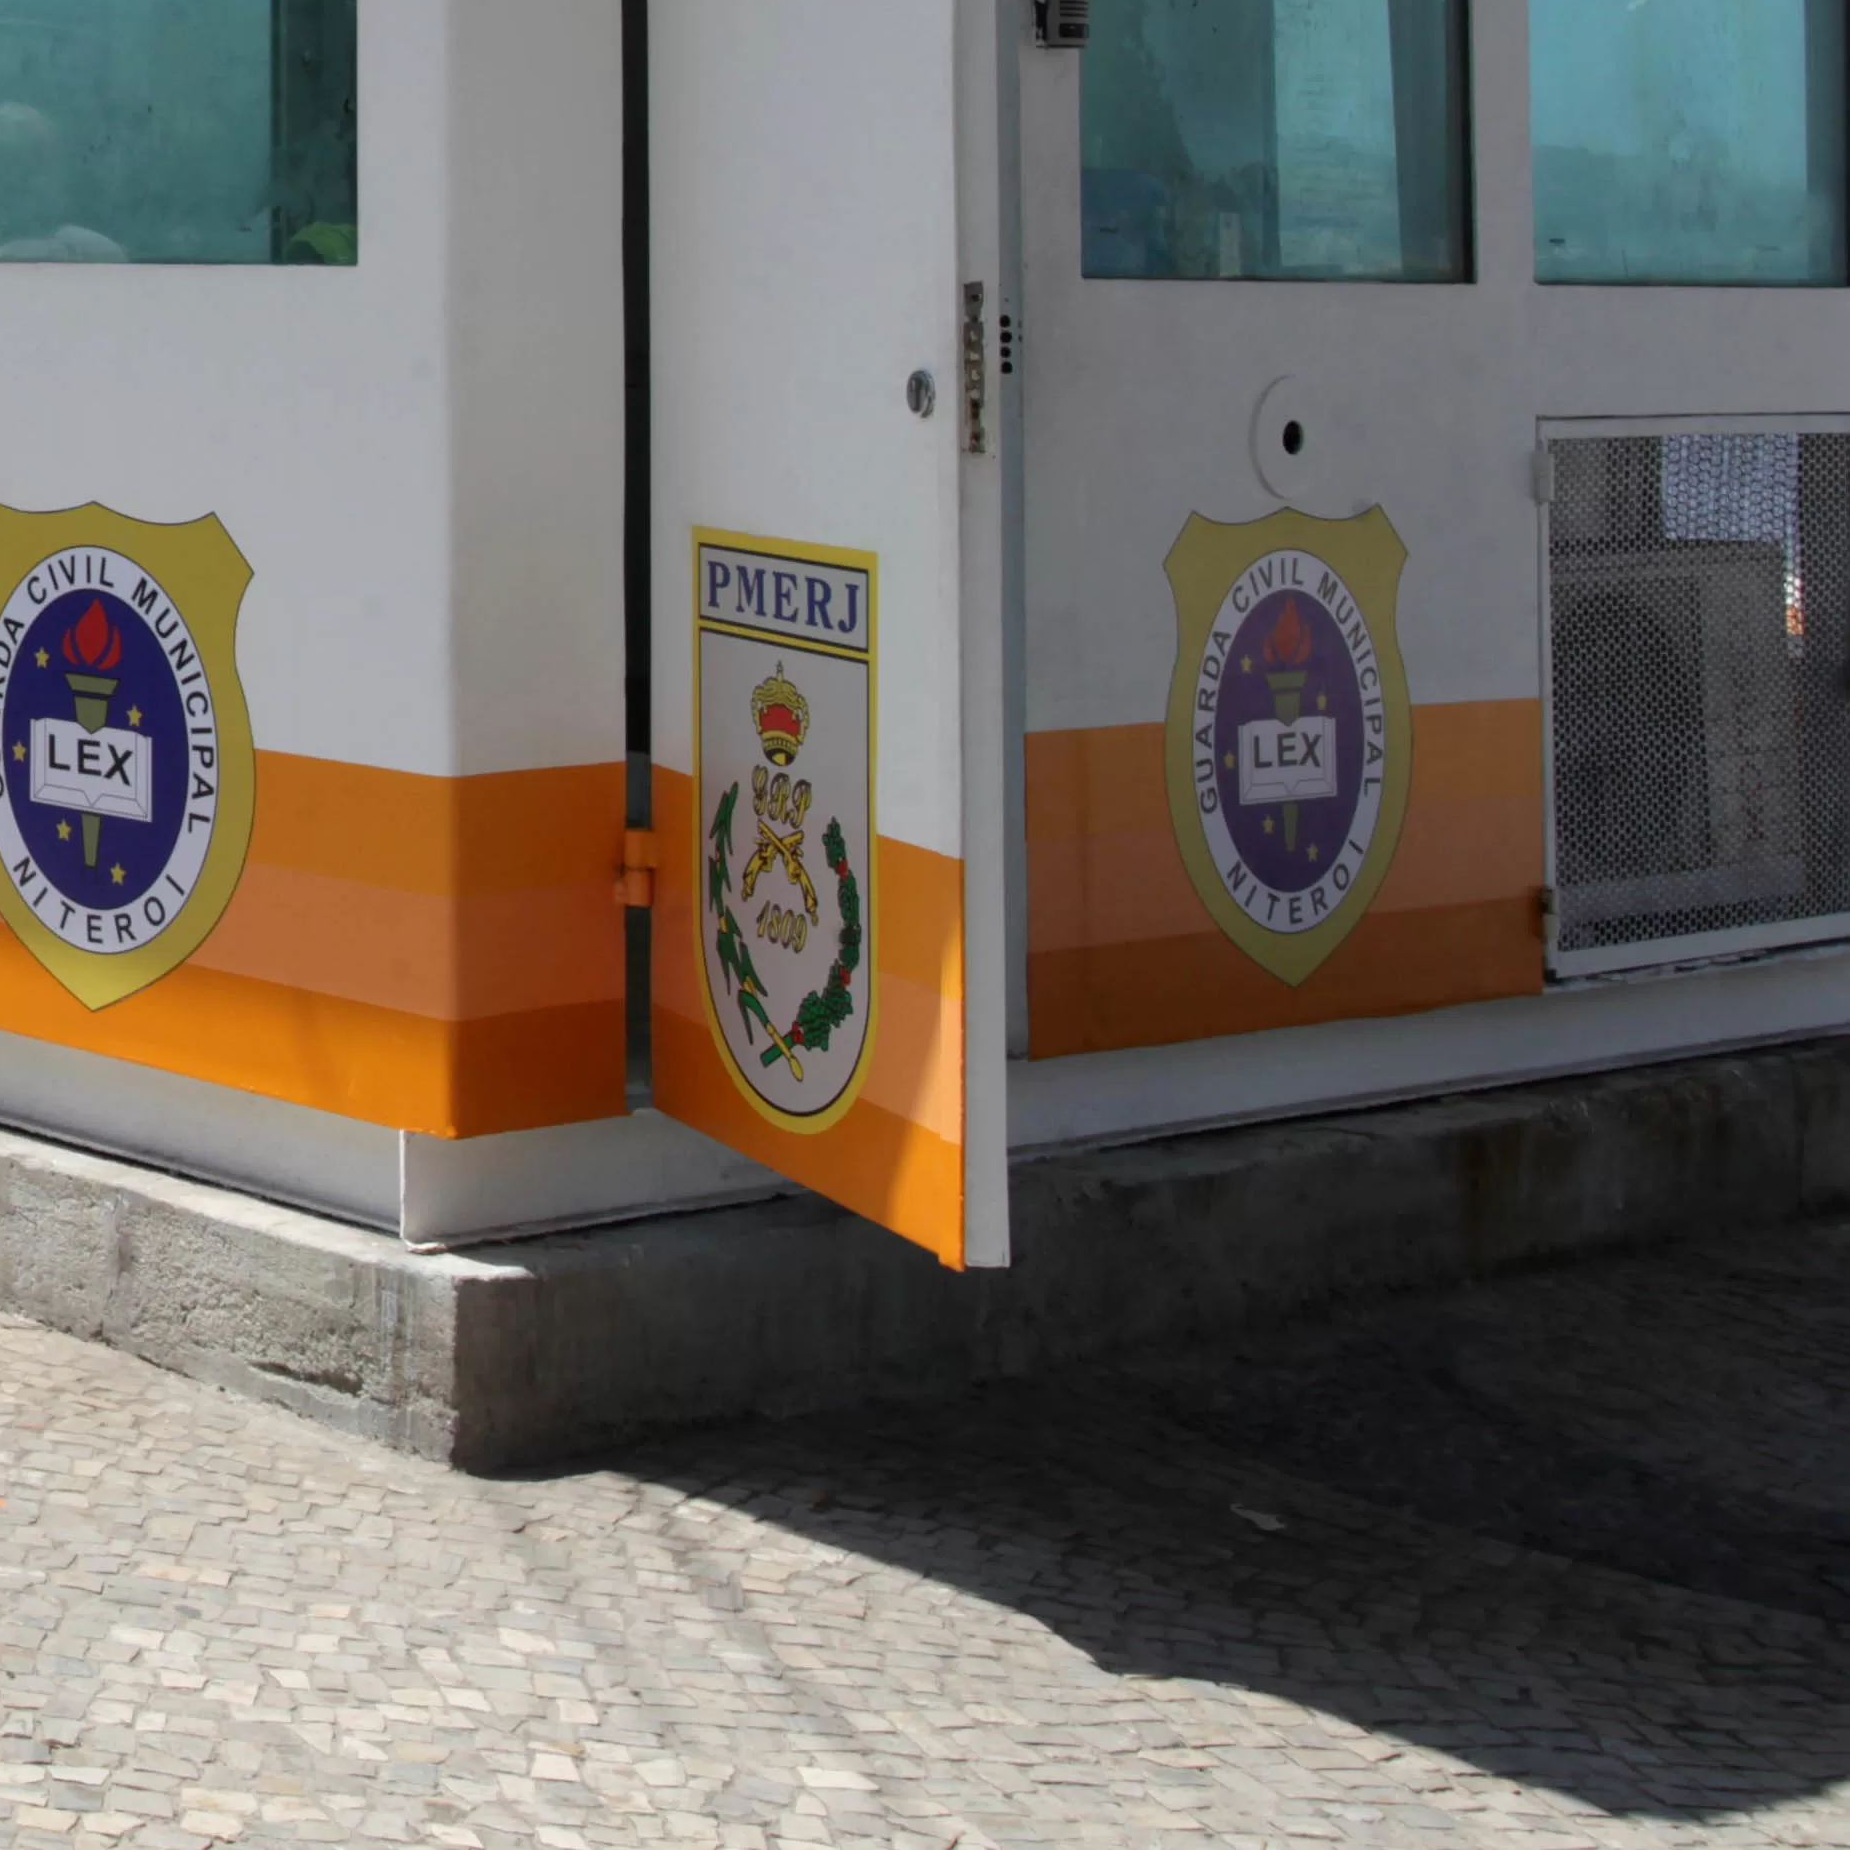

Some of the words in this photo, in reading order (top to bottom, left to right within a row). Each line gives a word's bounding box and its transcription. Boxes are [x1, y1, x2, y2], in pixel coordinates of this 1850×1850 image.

[707, 559, 861, 633] PMERJ
[26, 553, 114, 605] CIVIL
[131, 577, 216, 834] MUNICIPAL
[1194, 628, 1232, 814] GUARDA
[1232, 556, 1304, 614] CIVIL
[1317, 570, 1384, 798] MUNICIPAL
[48, 733, 134, 786] LEX
[1253, 732, 1322, 770] LEX
[13, 855, 187, 944] NITEROI
[1226, 838, 1364, 925] NITEROI
[756, 899, 807, 954] 1809
